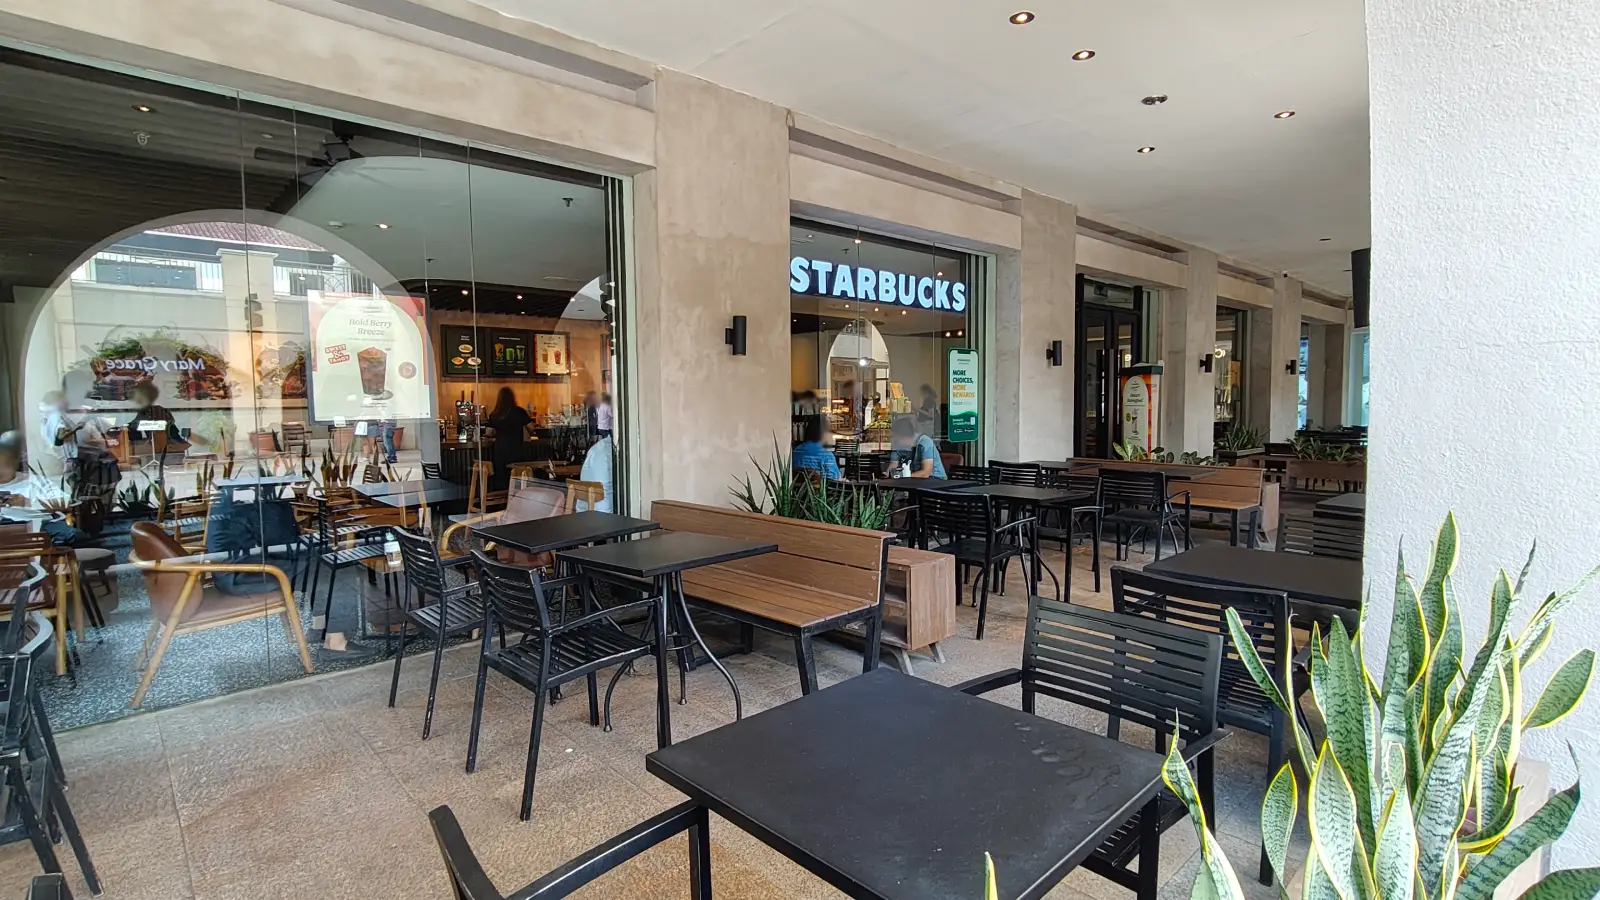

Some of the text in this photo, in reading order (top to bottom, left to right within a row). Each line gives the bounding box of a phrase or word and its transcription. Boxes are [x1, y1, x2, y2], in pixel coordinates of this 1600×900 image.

[790, 256, 966, 312] STARBUCKS
[349, 318, 393, 329] Bold Berry
[357, 327, 385, 336] Breeze
[325, 344, 346, 353] SWEET
[328, 355, 349, 364] TANGY
